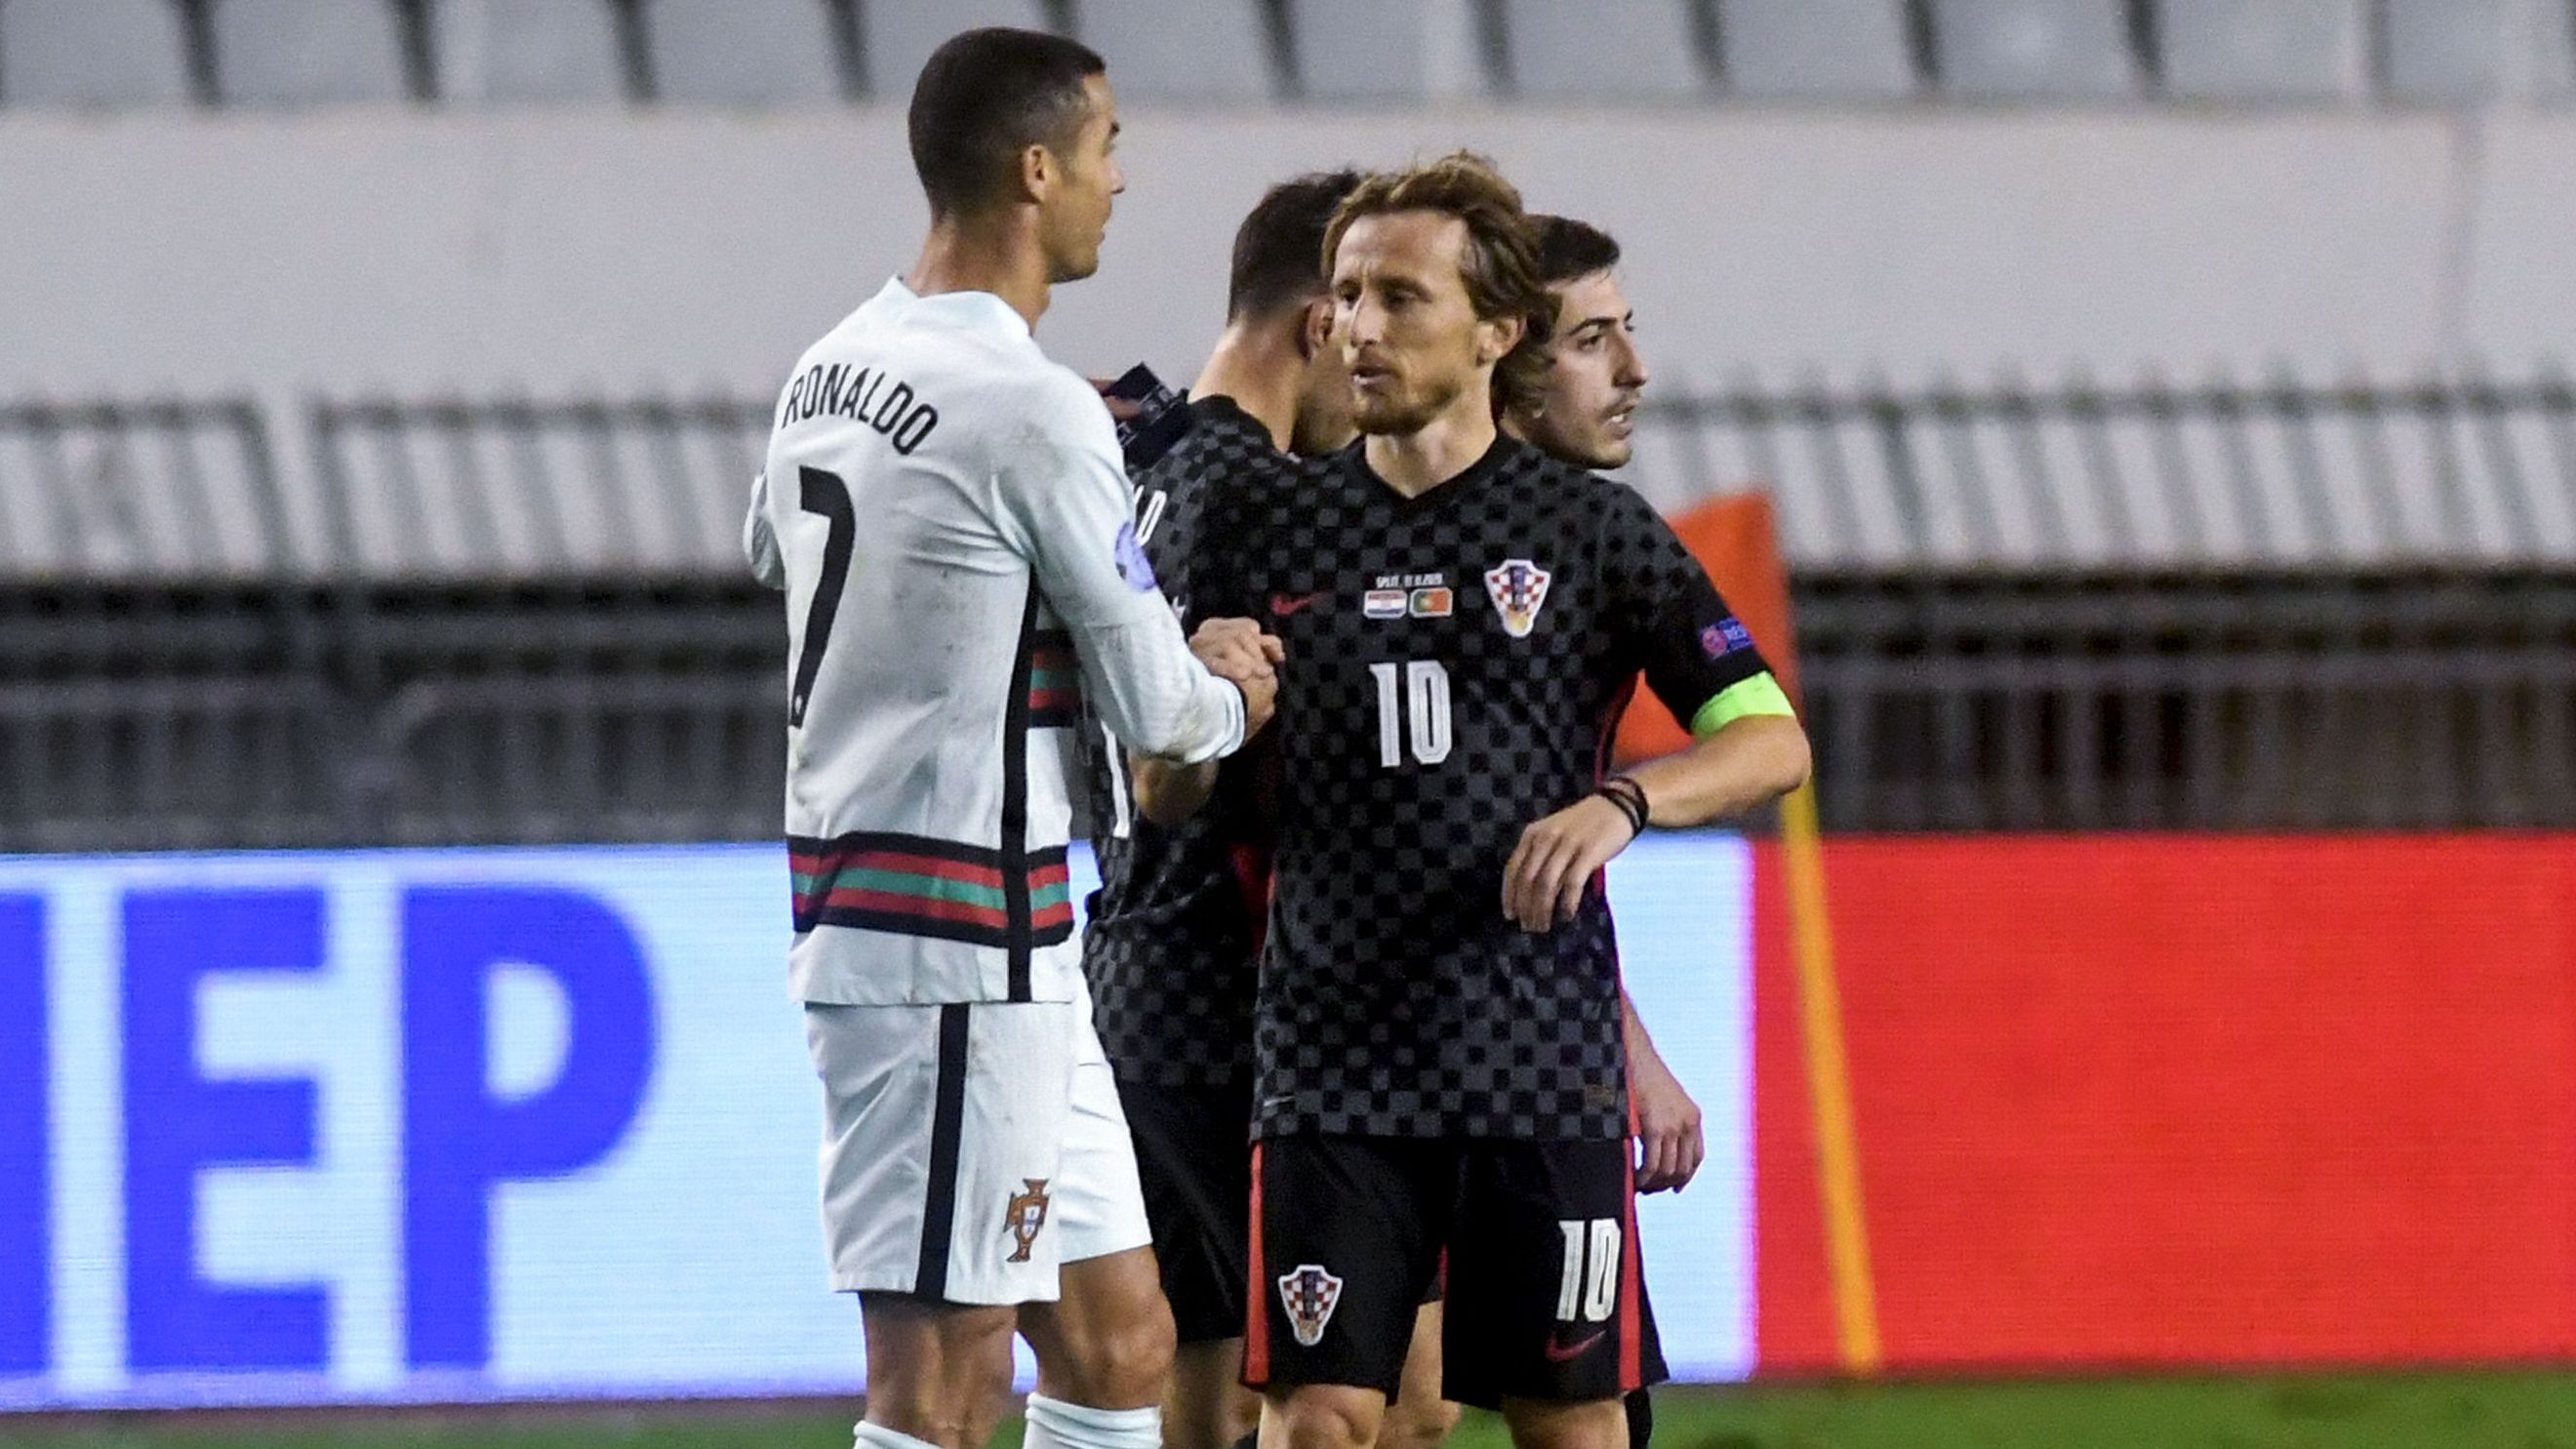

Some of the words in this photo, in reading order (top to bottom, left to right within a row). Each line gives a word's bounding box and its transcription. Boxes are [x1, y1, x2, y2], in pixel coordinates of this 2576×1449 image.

[782, 363, 938, 456] RONALDO
[788, 465, 856, 730] 7
[1369, 660, 1453, 767] 10
[1555, 1218, 1622, 1322] 10
